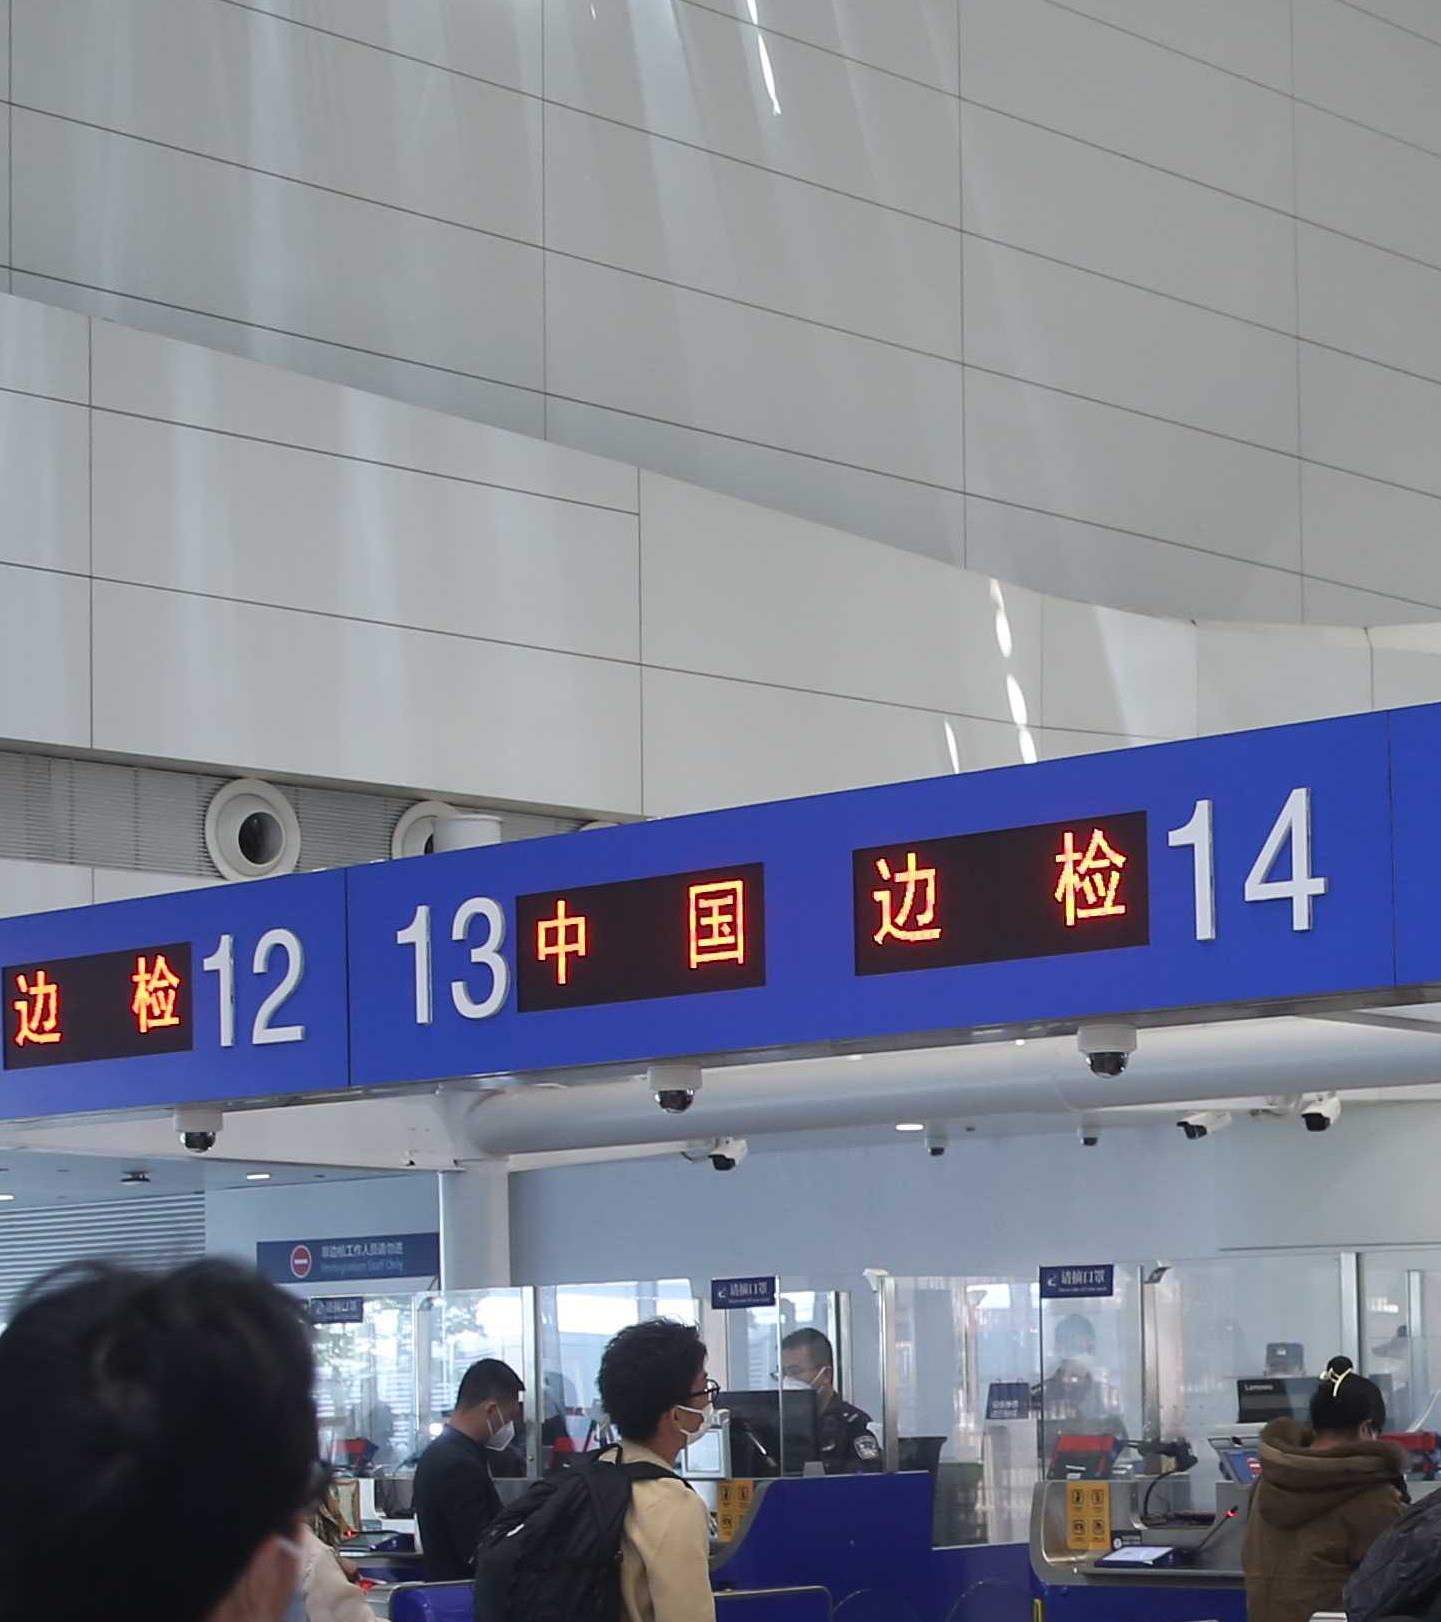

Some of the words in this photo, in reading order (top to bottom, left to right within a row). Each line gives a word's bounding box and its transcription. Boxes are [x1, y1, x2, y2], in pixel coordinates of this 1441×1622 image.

[871, 830, 1128, 944] 边检
[1169, 788, 1327, 940] 14
[204, 928, 305, 1047] 12
[397, 897, 508, 1025] 13
[536, 879, 745, 983] 中国
[12, 953, 181, 1046] 边检
